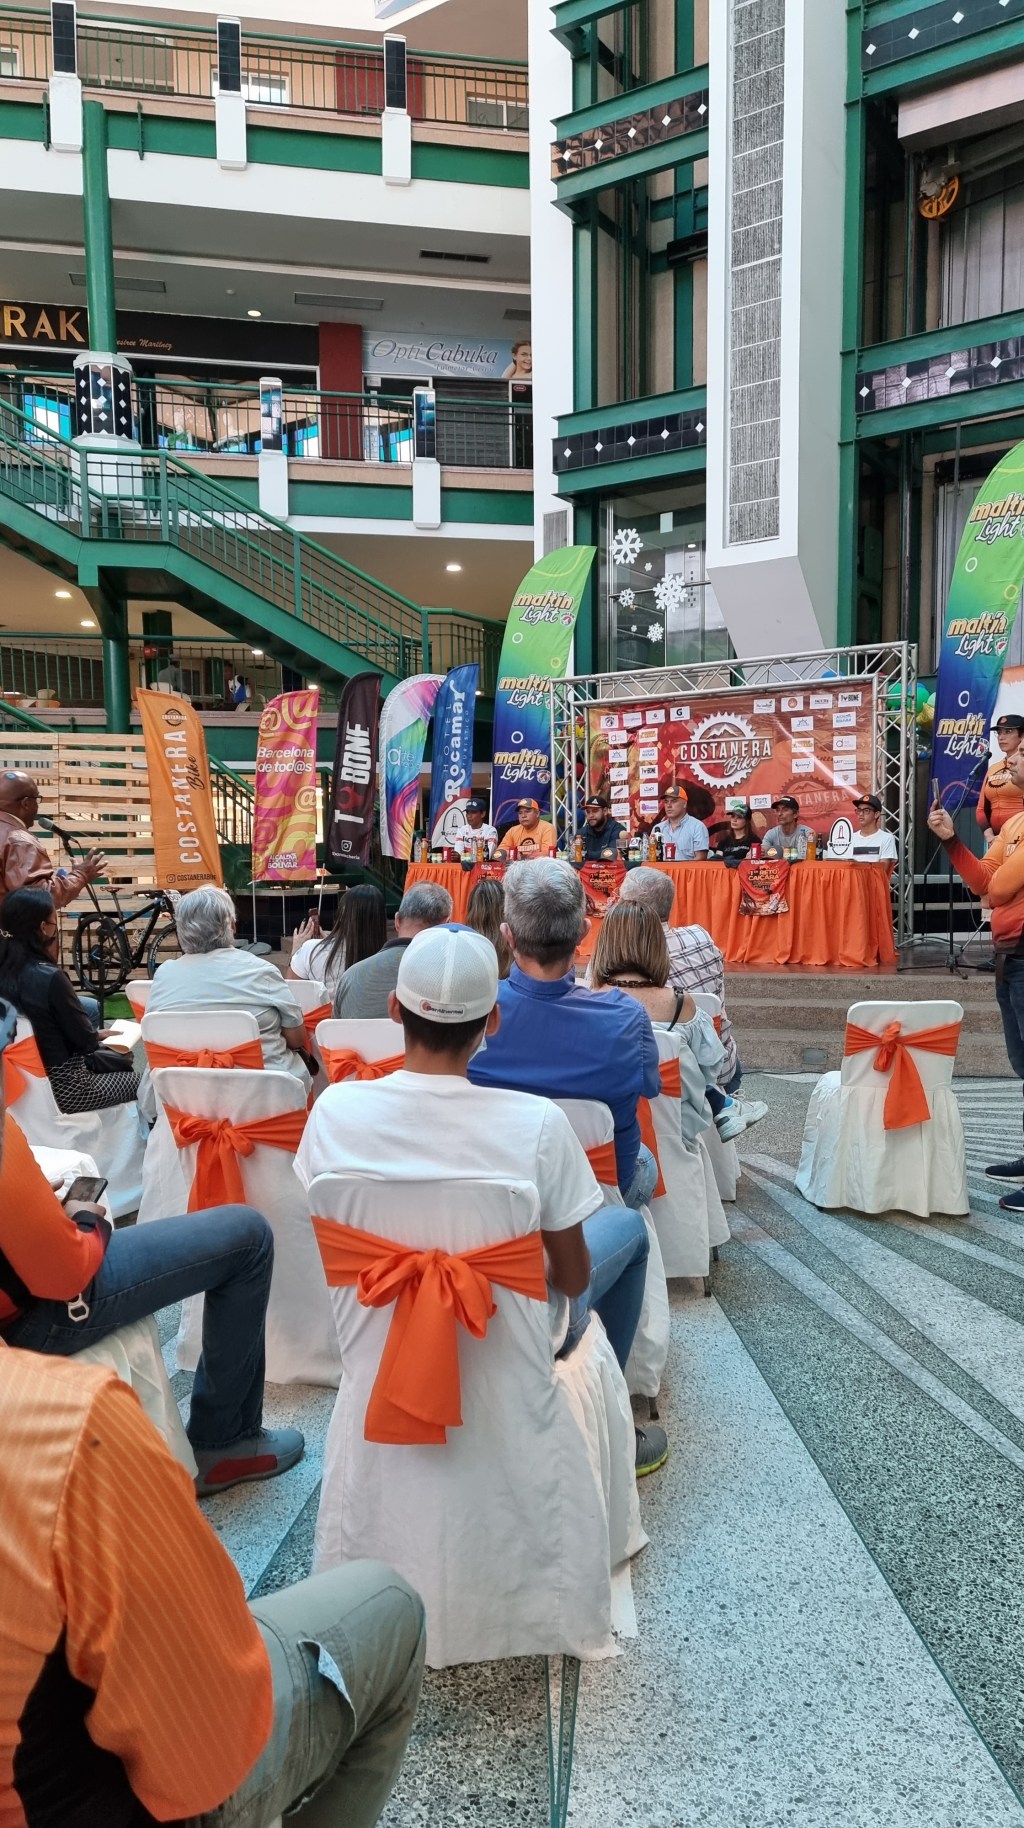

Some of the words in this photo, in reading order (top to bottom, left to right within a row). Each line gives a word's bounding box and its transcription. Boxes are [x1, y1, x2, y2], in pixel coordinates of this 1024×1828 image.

[0, 305, 86, 343] RAK
[372, 339, 424, 364] Opti
[426, 342, 498, 364] Cabuka
[970, 492, 1024, 522] maltí
[975, 511, 1019, 545] Light
[514, 590, 573, 609] maltín
[519, 603, 559, 625] Light
[947, 611, 1007, 637] maltín
[955, 630, 993, 660] Light
[507, 687, 544, 709] Light
[443, 703, 452, 773] HOTEL
[444, 679, 466, 803] Rocamar
[680, 739, 772, 760] COSTANERA
[944, 732, 977, 760] Light
[257, 746, 315, 759] Barcelona
[494, 749, 547, 767] maltín
[186, 755, 205, 791] Bike
[258, 760, 273, 772] de
[274, 760, 313, 774] tod@s
[500, 763, 535, 784] Light
[723, 756, 760, 776] Bike
[163, 730, 203, 864] COSTANERA
[772, 790, 849, 807] CTANERA
